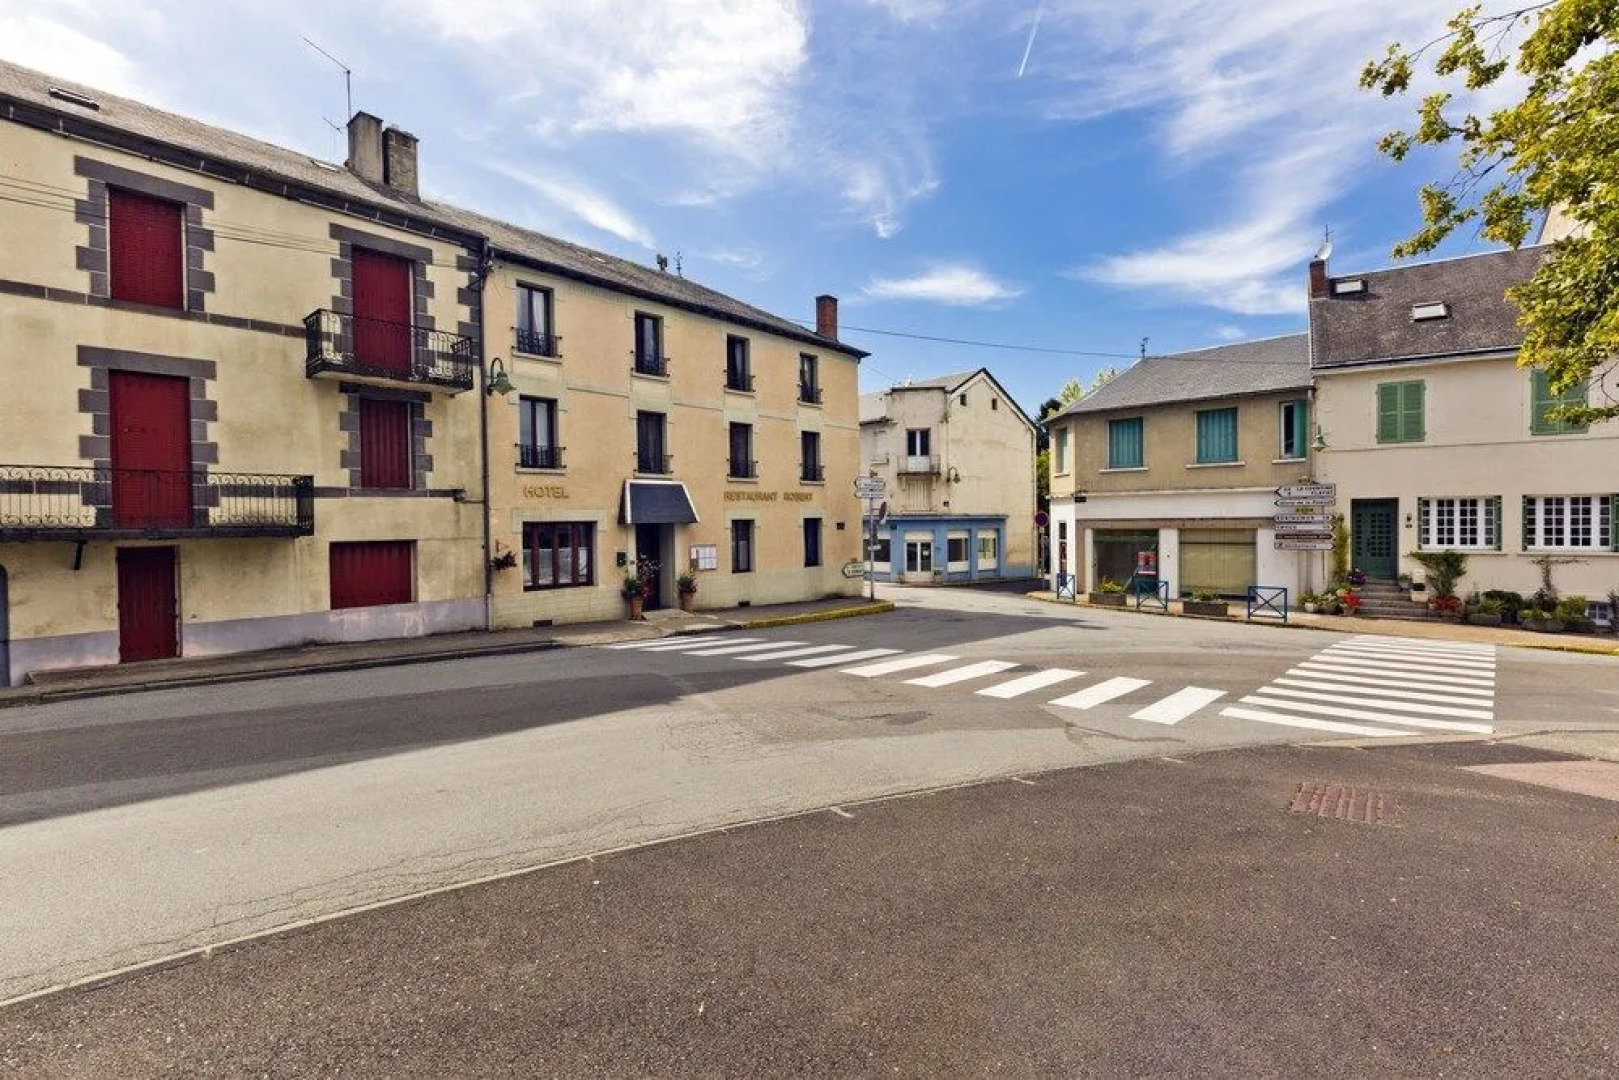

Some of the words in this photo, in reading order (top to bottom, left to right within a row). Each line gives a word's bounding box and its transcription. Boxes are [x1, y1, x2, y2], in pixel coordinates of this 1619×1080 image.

[523, 486, 570, 499] HOTEL
[723, 491, 777, 501] RESTAURANT
[783, 491, 814, 502] ROBERT
